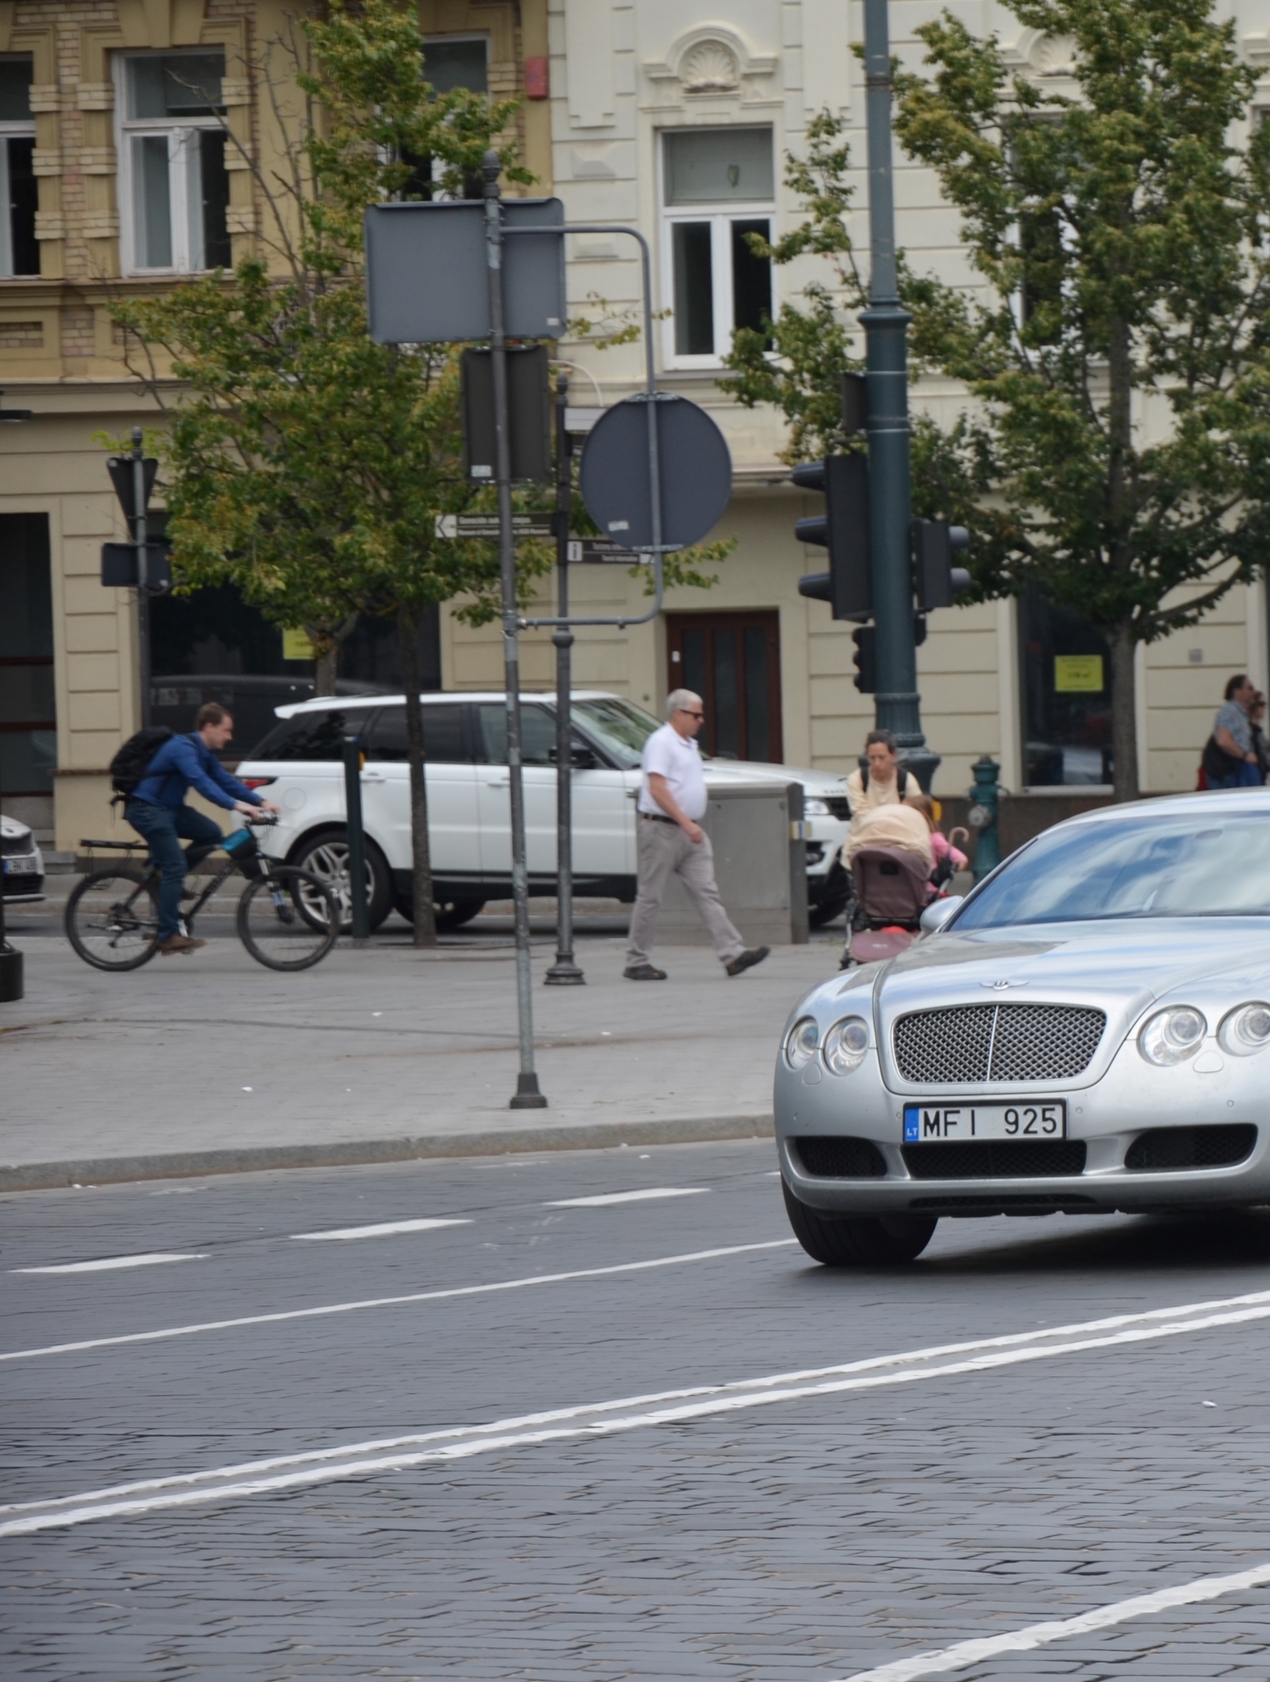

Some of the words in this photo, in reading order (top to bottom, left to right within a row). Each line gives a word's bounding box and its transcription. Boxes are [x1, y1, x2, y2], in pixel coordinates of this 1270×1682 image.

[906, 1128, 918, 1137] LT
[923, 1109, 975, 1137] MFI
[1003, 1107, 1057, 1135] 925
